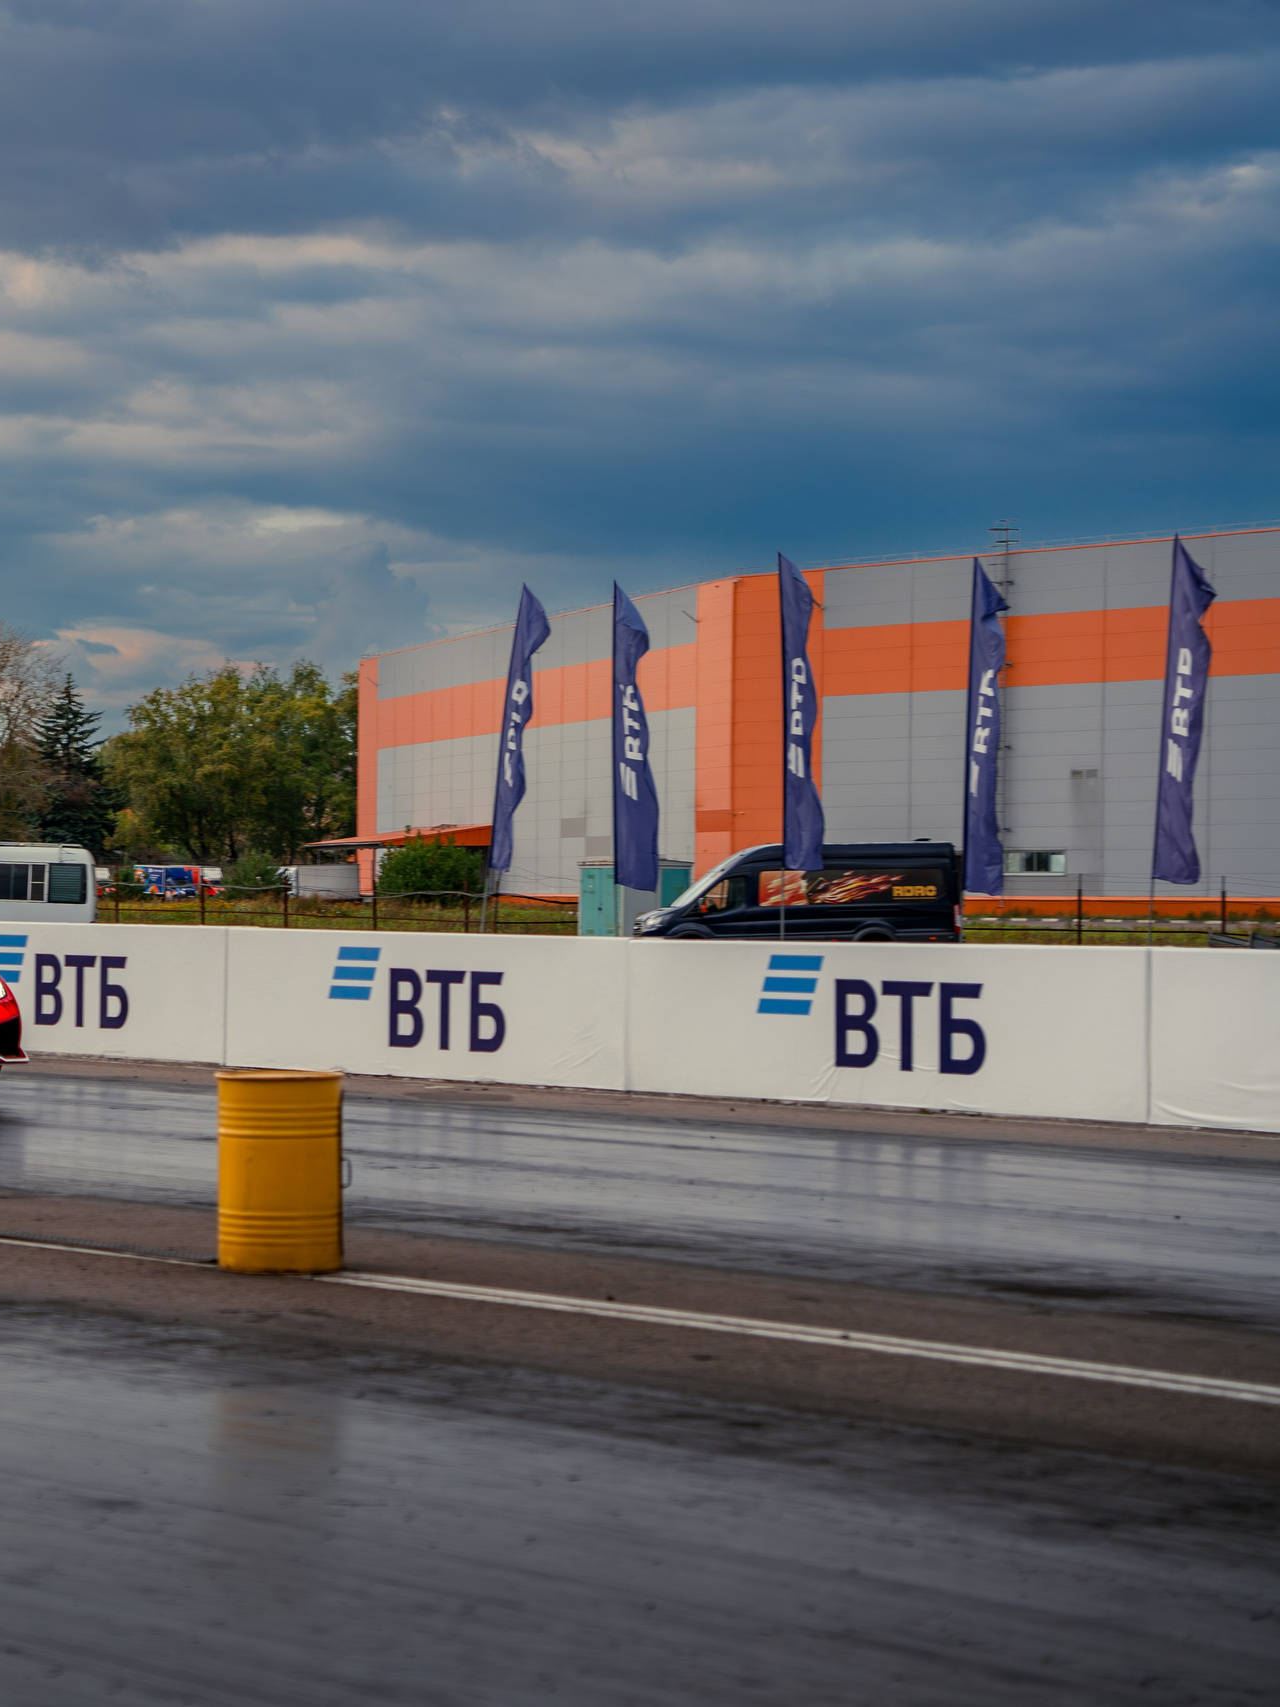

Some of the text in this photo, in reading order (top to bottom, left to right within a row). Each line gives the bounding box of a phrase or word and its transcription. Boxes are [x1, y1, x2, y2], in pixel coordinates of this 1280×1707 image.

[34, 953, 129, 1030] ВТБ
[388, 967, 506, 1053] ВТБ
[834, 978, 987, 1076] ВТБ
